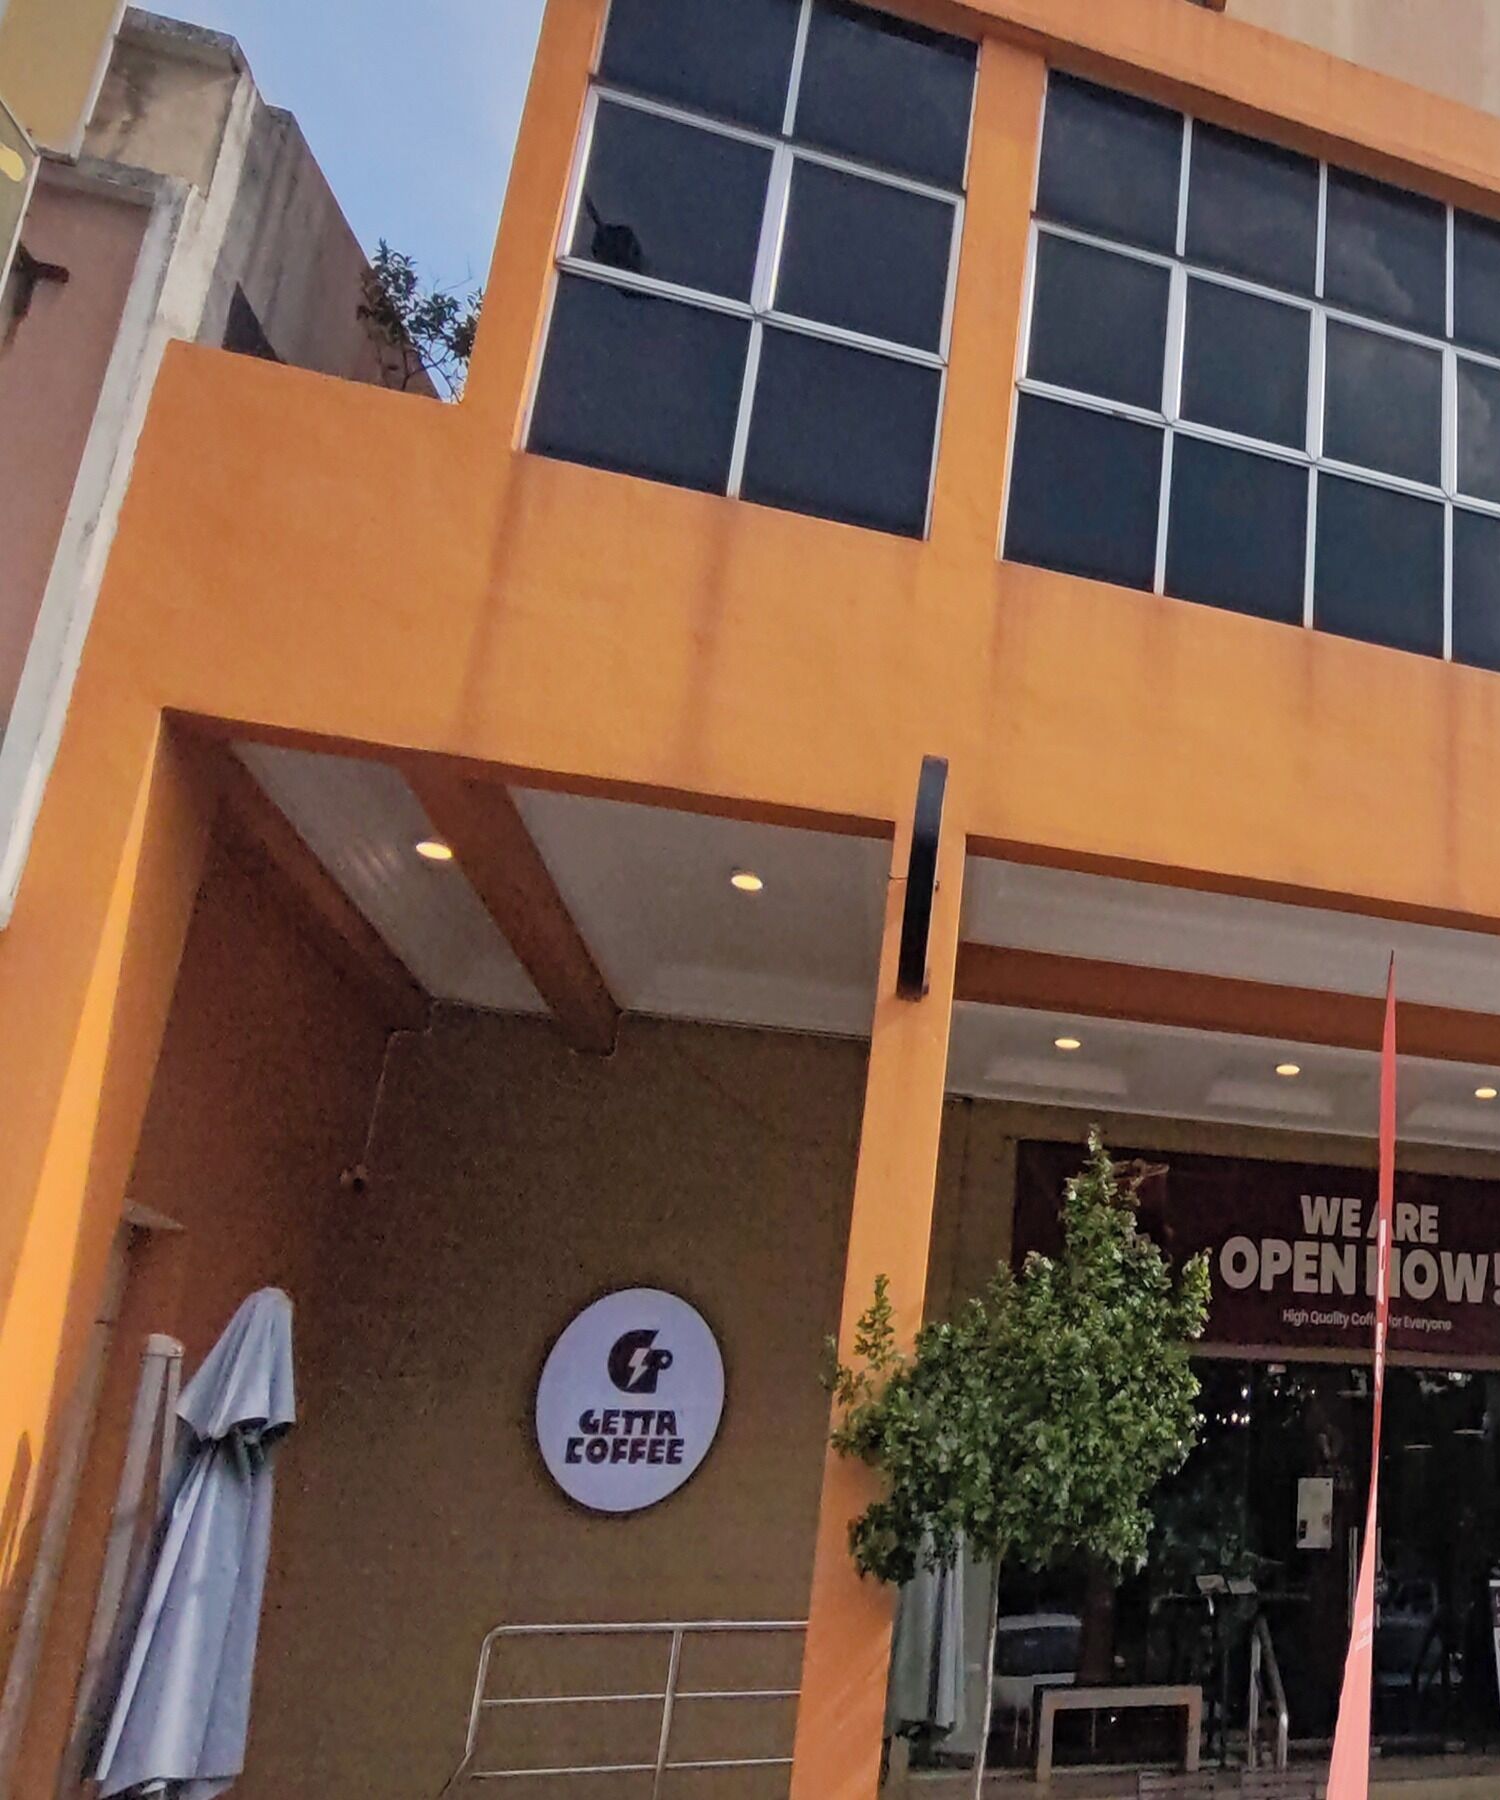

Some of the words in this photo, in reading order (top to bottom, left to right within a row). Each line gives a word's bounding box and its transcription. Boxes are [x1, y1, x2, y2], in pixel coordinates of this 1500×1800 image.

[1300, 1195, 1362, 1237] WE
[1219, 1236, 1357, 1296] OPEN
[1282, 1309, 1309, 1327] High
[1310, 1311, 1349, 1329] Quality
[1351, 1312, 1376, 1326] Coff
[579, 1409, 677, 1436] GETTA
[565, 1437, 684, 1465] COFFEE
